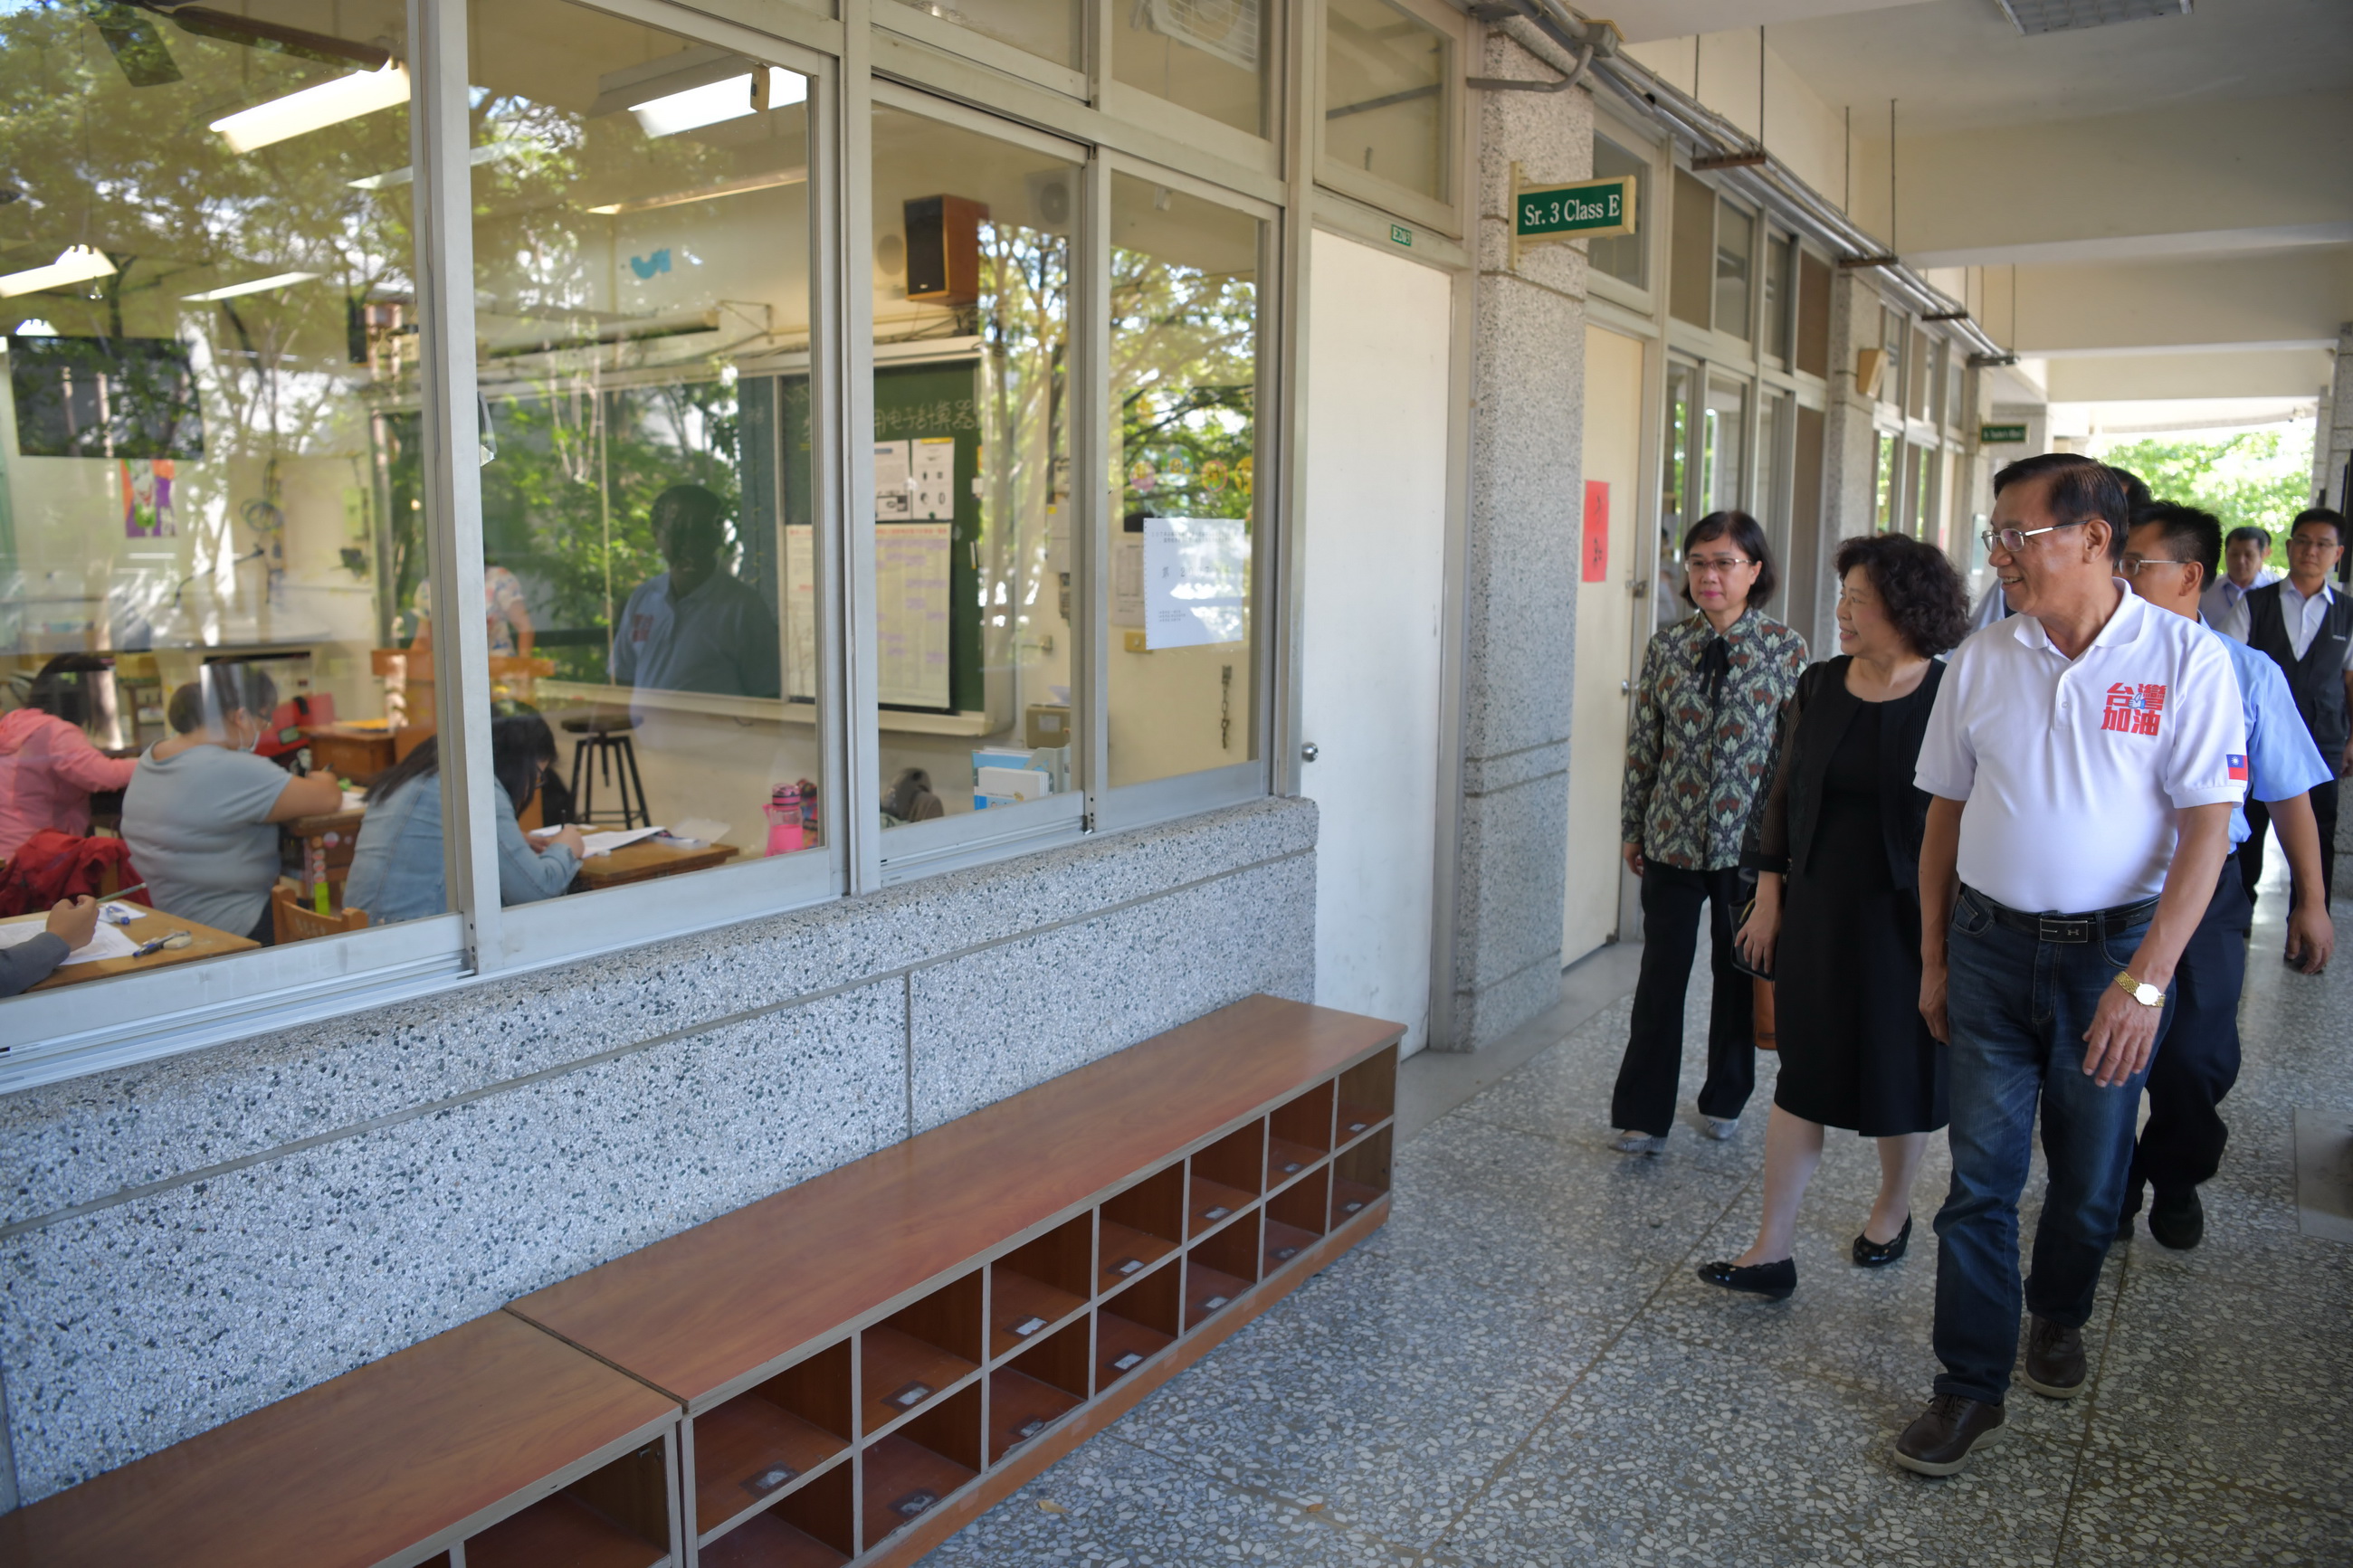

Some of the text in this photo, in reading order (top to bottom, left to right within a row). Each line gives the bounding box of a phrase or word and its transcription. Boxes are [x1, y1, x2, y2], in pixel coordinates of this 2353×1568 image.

[1524, 194, 1621, 226] Sr. 3 Class E
[2106, 682, 2167, 711] 台灣
[2101, 706, 2161, 736] 加油
